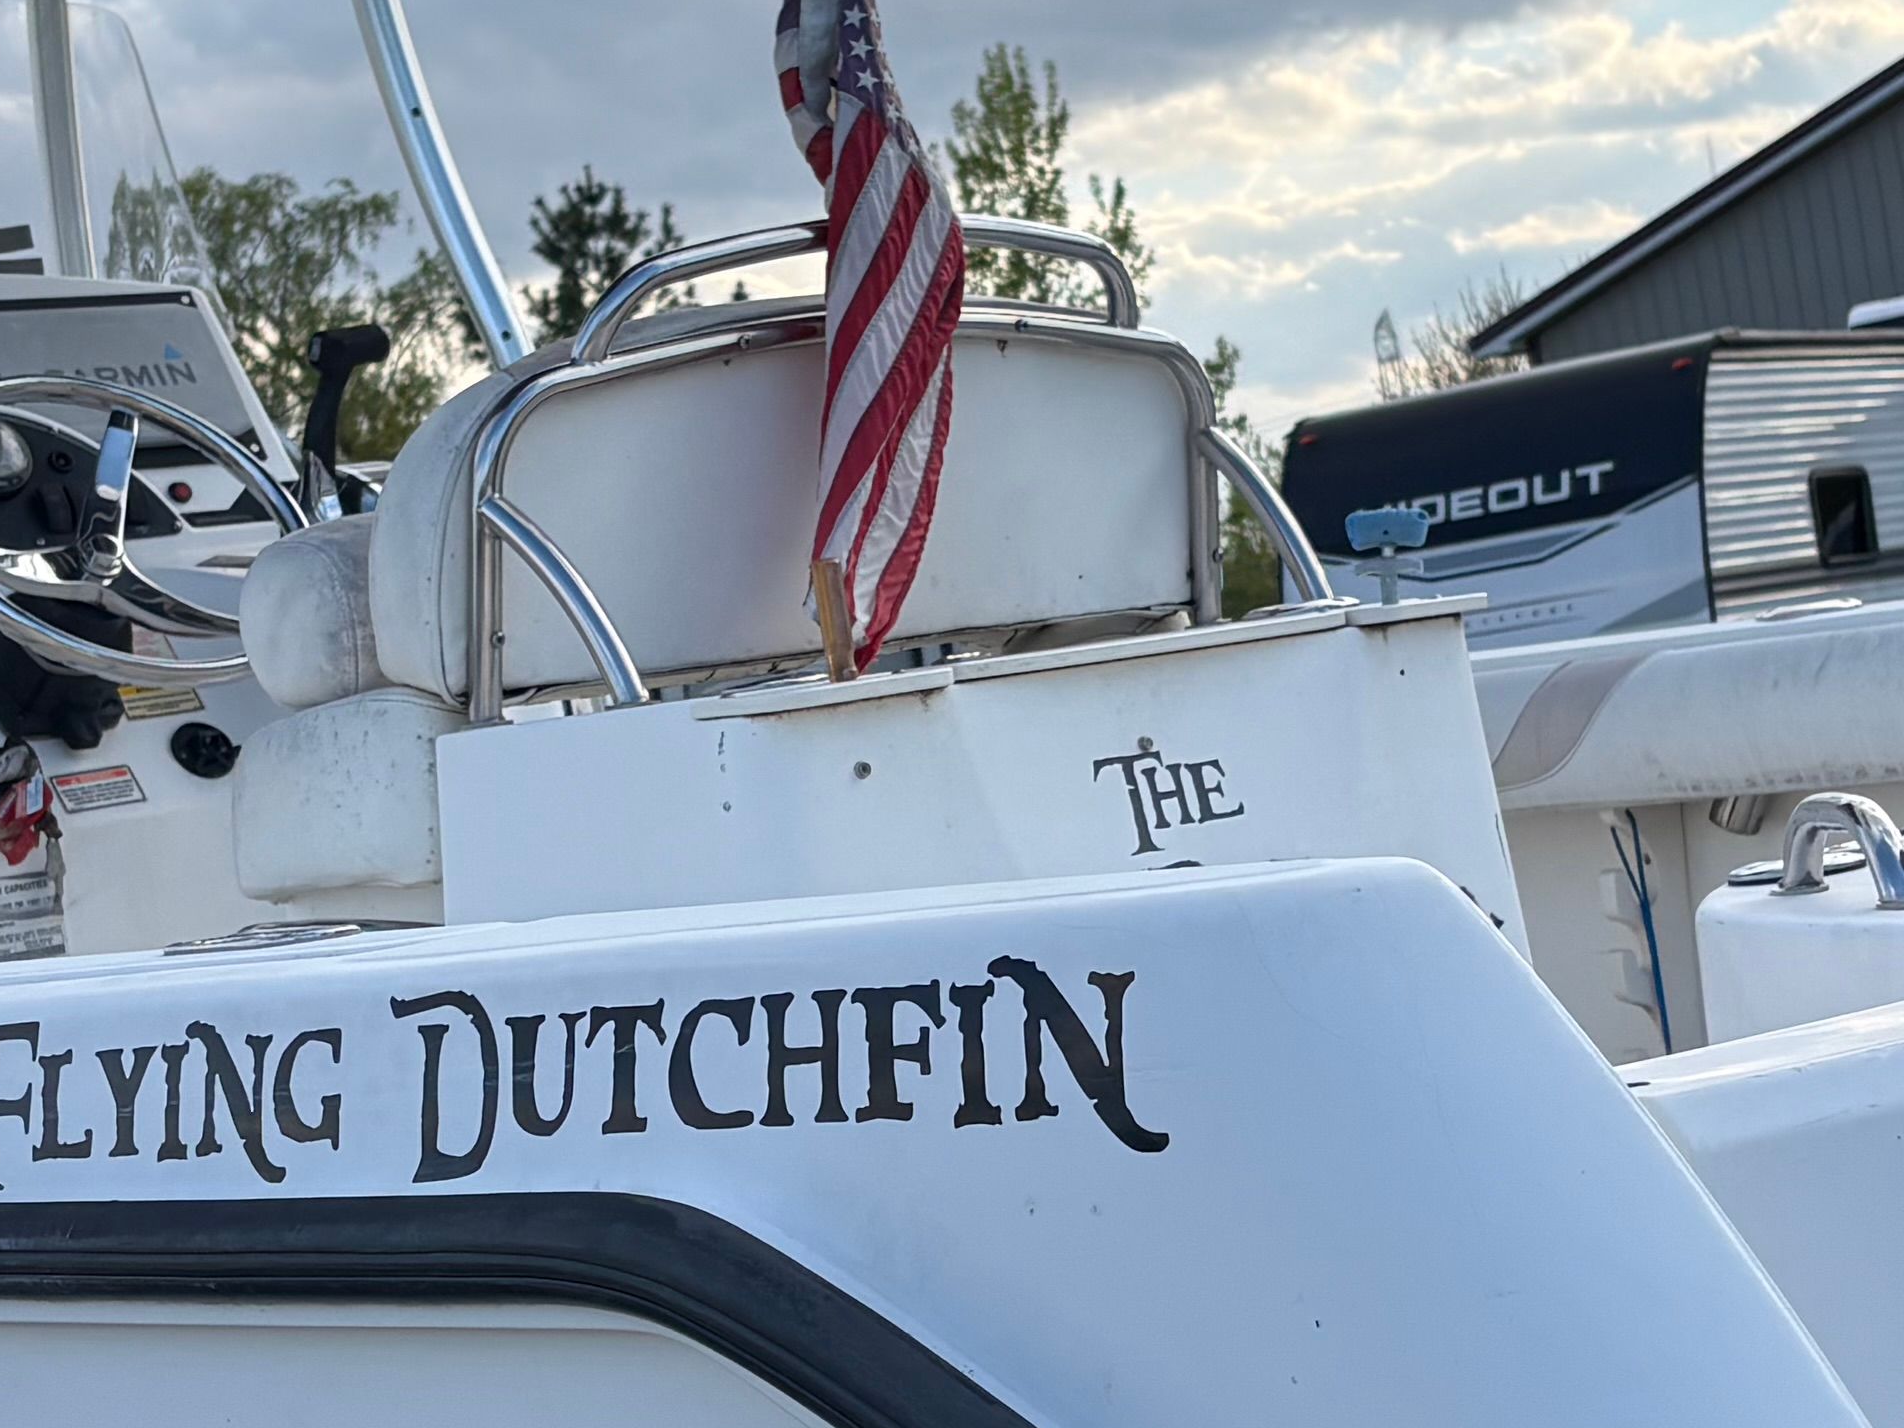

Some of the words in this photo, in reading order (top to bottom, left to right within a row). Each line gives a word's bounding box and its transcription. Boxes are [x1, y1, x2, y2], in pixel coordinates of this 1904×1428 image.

[1382, 460, 1614, 526] DEOUT
[1093, 750, 1244, 856] THE
[4, 879, 48, 894] CAPACITIES
[390, 955, 1170, 1183] DUTCHFIN
